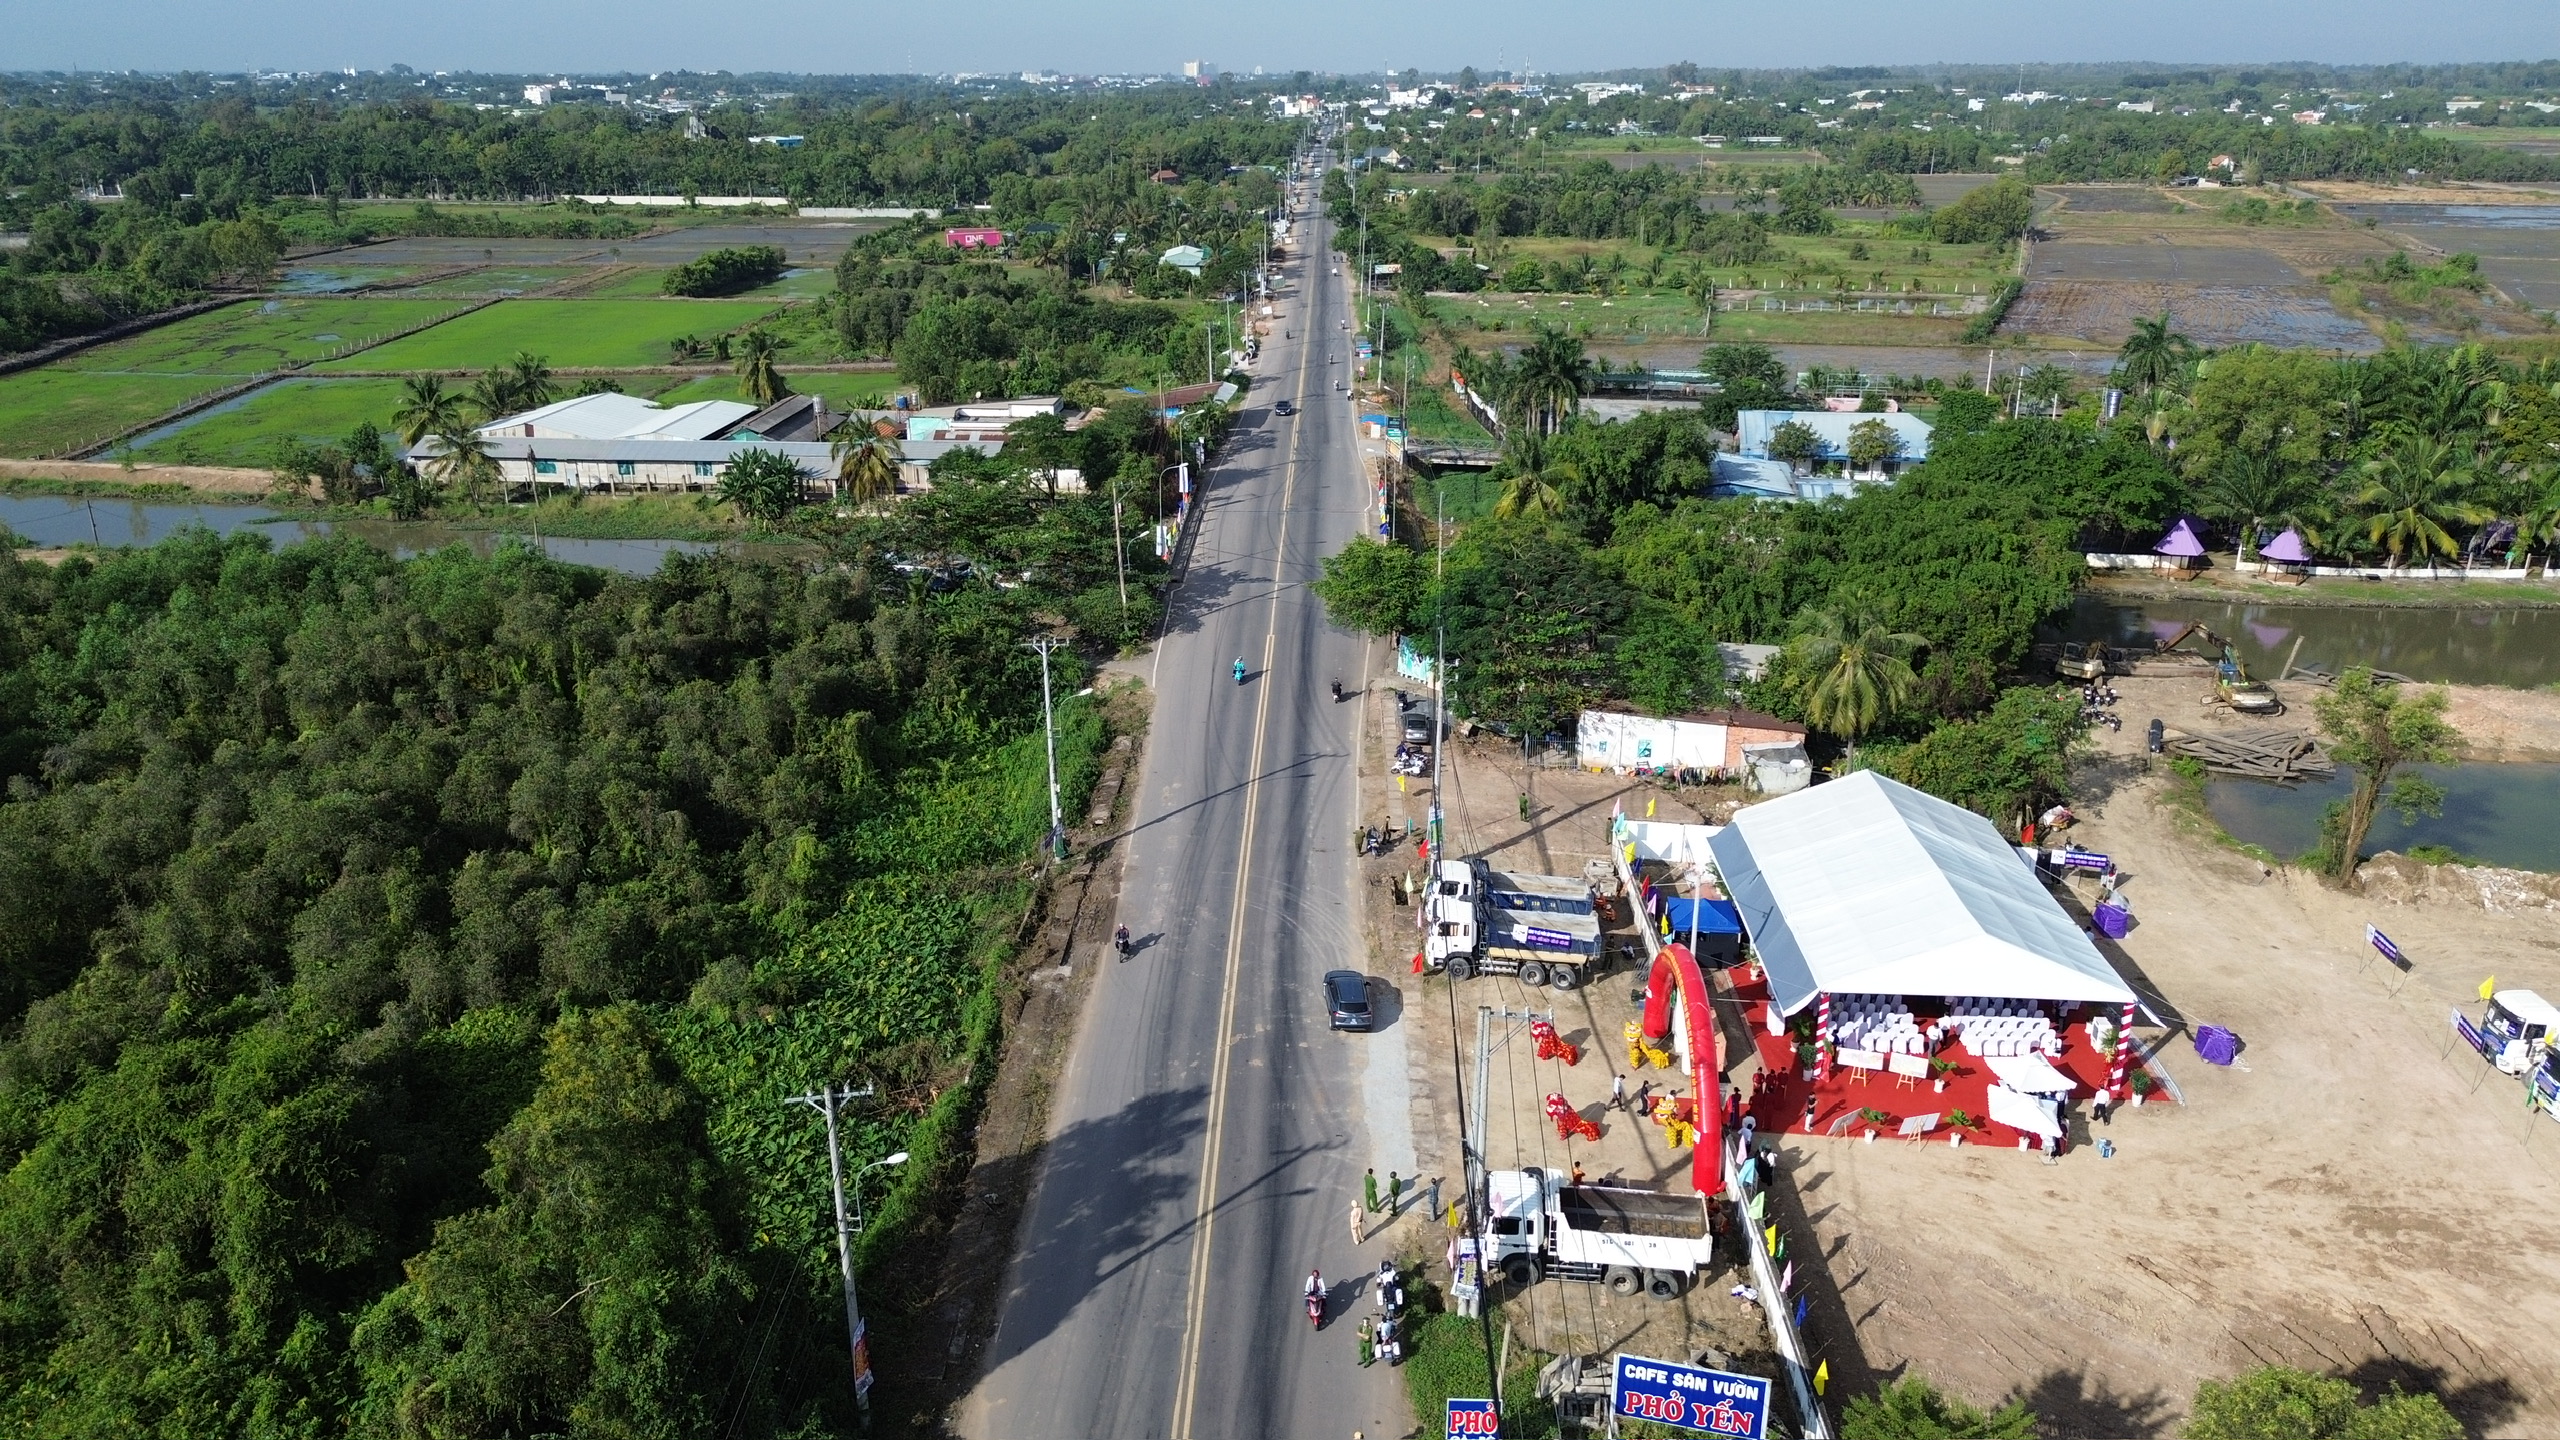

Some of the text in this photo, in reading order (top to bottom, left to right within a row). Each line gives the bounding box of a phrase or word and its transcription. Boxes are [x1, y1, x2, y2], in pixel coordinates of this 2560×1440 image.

[1624, 1364, 1759, 1401] CAFE SÂN VƯỜN
[1624, 1390, 1754, 1435] PHỞ YẾN
